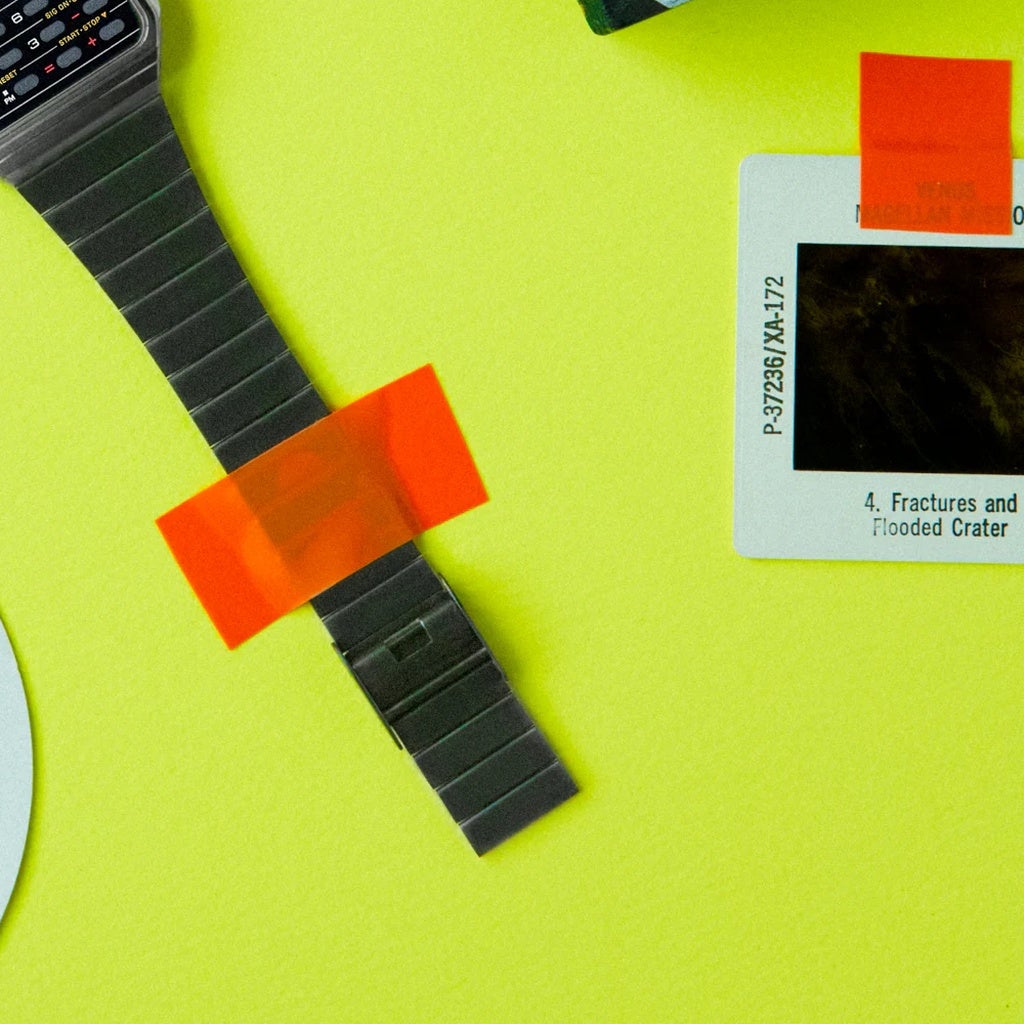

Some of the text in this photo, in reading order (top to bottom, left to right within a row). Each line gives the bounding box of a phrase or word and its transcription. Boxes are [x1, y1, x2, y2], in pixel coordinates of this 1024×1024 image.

[11, 12, 23, 24] 6
[45, 9, 58, 20] SIG
[27, 37, 40, 50] 3
[3, 94, 17, 105] PM
[763, 275, 788, 436] P-37236/XA-172
[864, 492, 1018, 513] 4. Fractures and
[872, 517, 1009, 537] Flooded Crater
